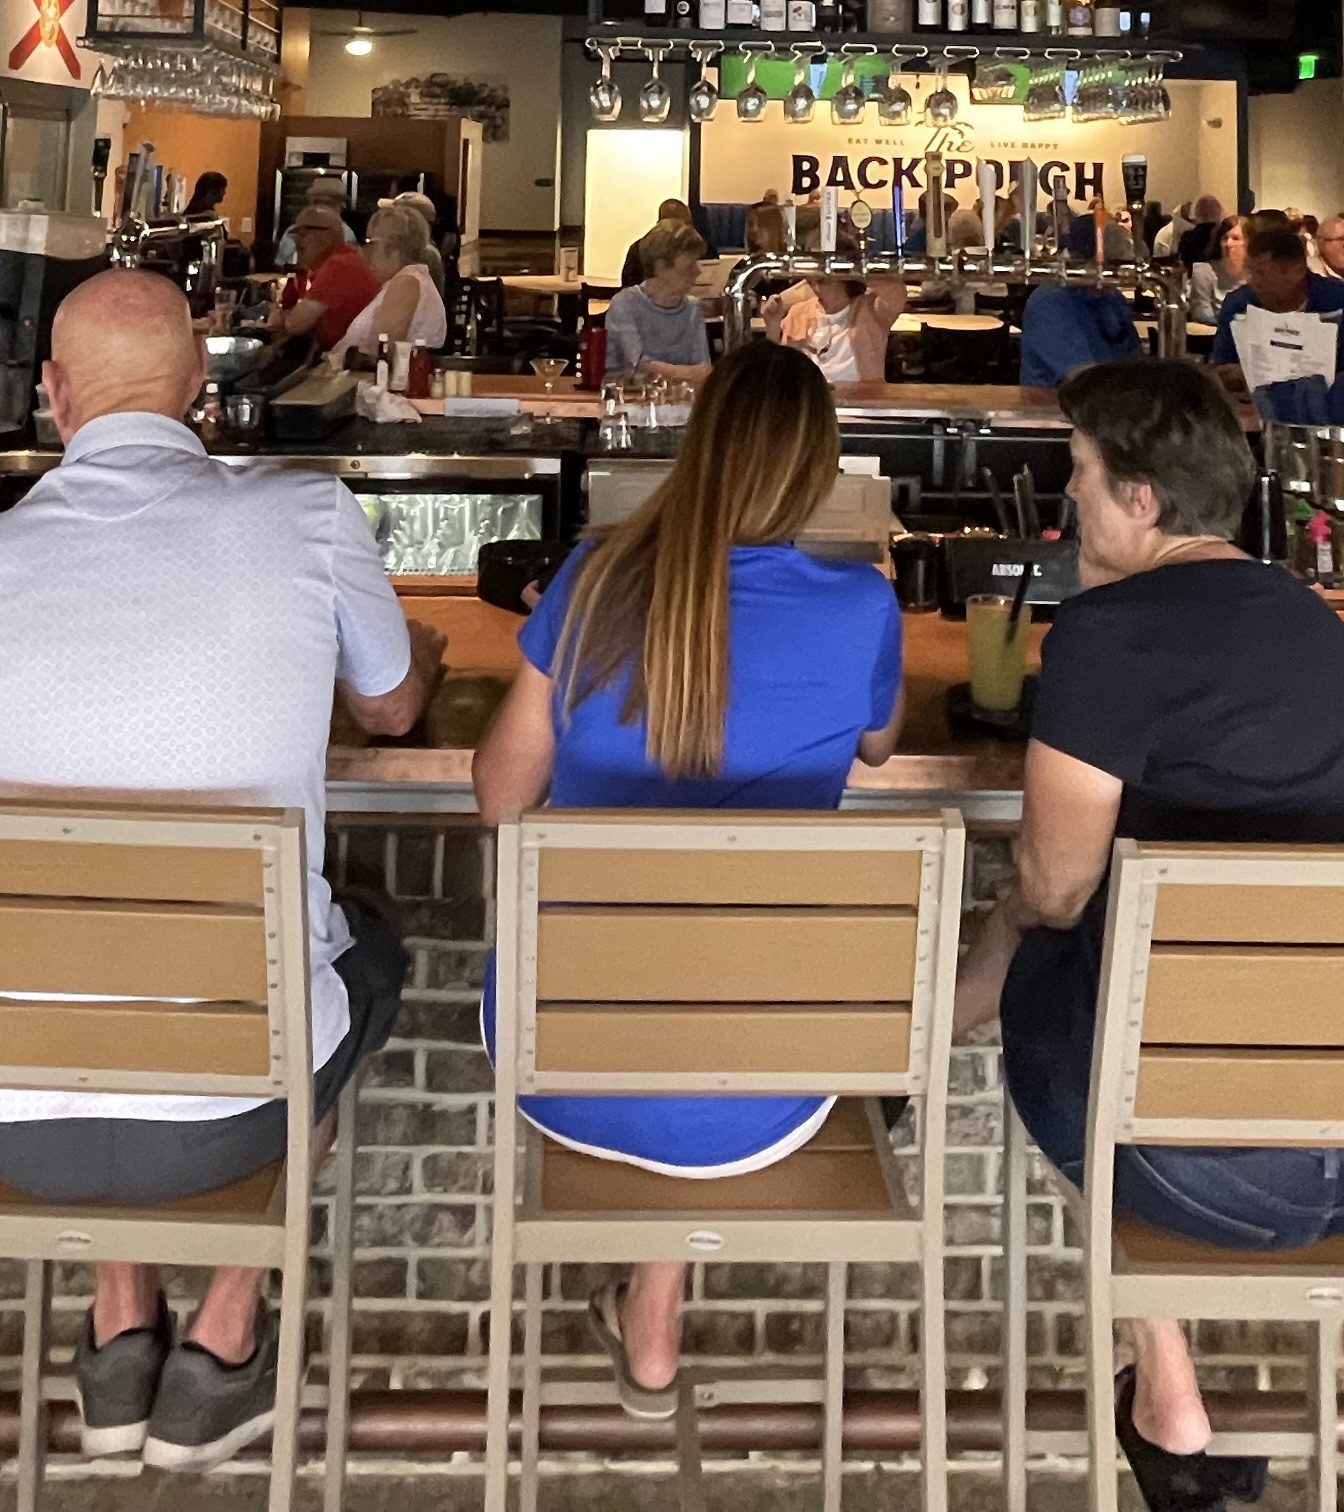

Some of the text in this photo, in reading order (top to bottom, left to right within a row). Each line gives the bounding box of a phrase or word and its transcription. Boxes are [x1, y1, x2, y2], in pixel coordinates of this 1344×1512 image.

[848, 137, 904, 146] EAT WELL
[1021, 142, 1059, 150] HAPPY
[791, 154, 924, 195] BACK
